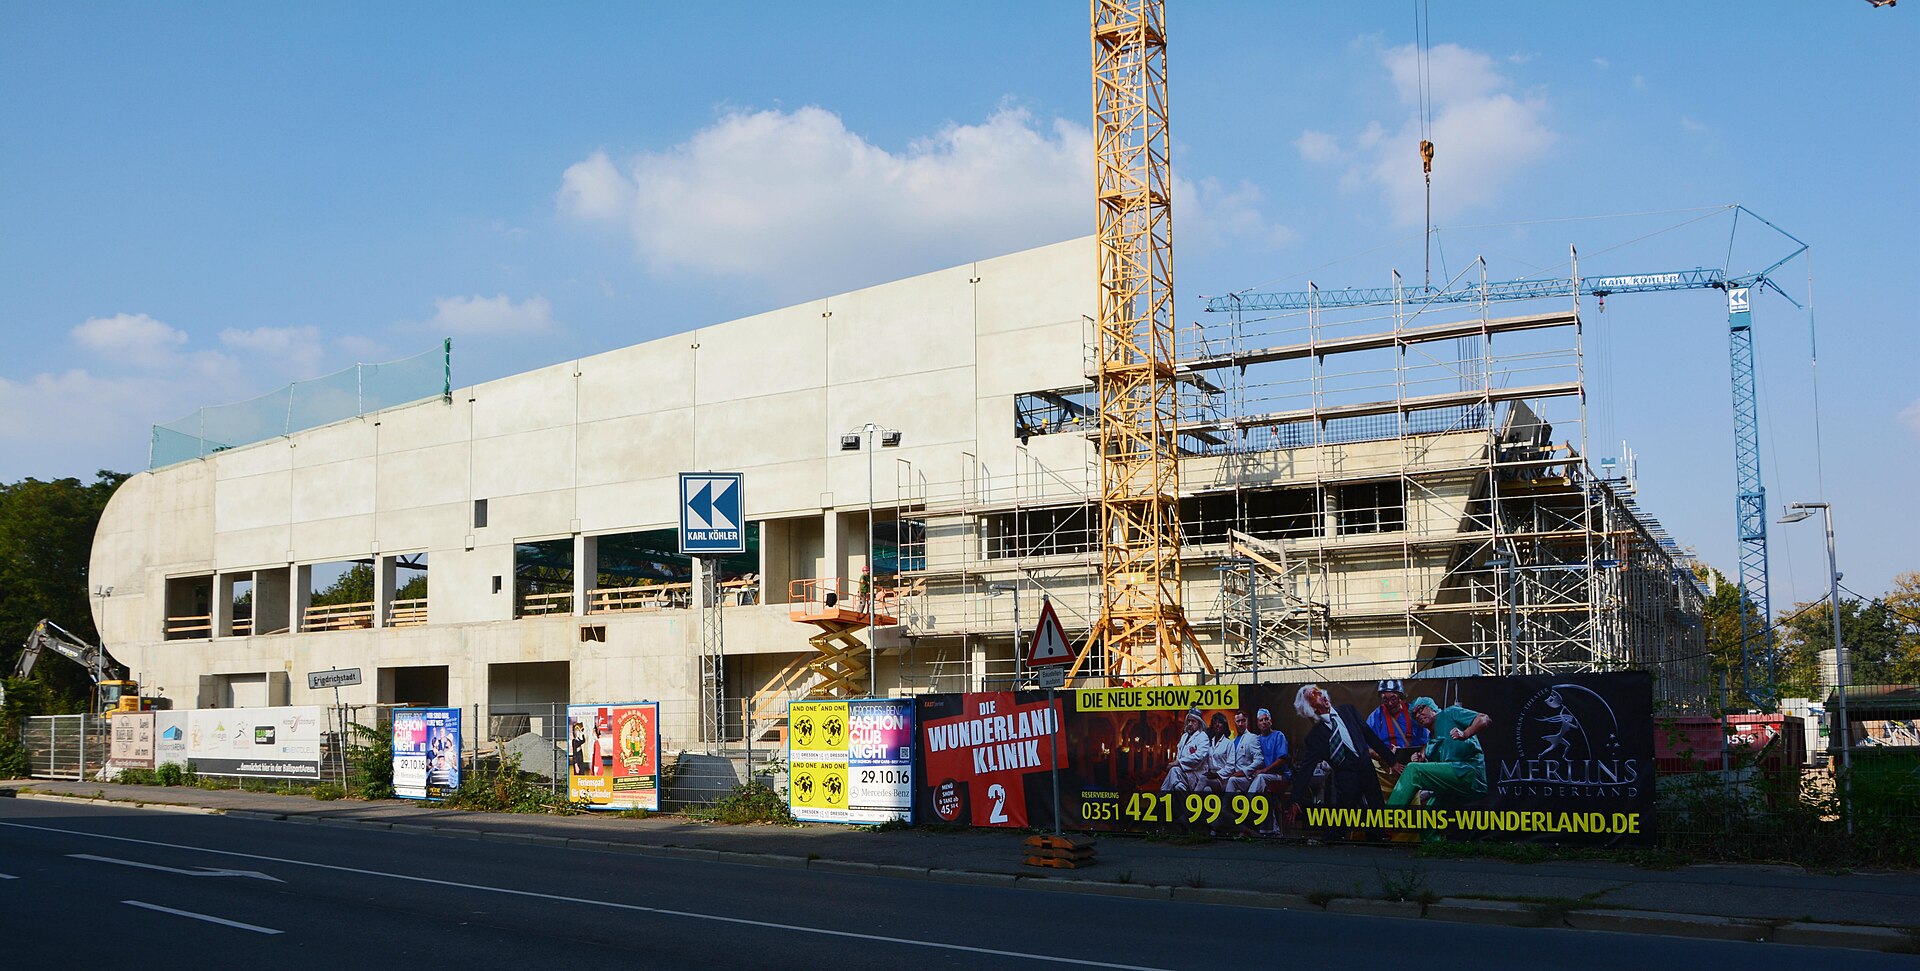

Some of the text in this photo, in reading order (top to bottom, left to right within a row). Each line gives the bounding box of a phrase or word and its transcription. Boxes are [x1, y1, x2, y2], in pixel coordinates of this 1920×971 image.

[688, 529, 738, 540] KARL KÖHLER
[313, 673, 356, 684] Friedrichstadt
[1082, 689, 1233, 708] DIE NEUE SHOW 2016
[979, 701, 996, 716] DIE
[394, 720, 423, 731] FASHION
[849, 715, 903, 730] FASHION
[394, 731, 412, 740] CLUB
[849, 730, 882, 743] CLUB
[928, 708, 1059, 752] WUNDERLAND
[394, 741, 416, 751] NIGHT
[849, 744, 888, 759] NIGHT
[973, 740, 1041, 774] KLINIK
[400, 759, 426, 770] 29.10.16
[861, 770, 910, 784] 29.10.16
[1499, 759, 1638, 784] MERLINS
[577, 777, 605, 788] Ferienspaß
[861, 788, 910, 797] Mercedes-Benz
[1081, 791, 1120, 799] RESERVIERUNG
[1498, 786, 1638, 798] WUNDERLAND
[987, 783, 1009, 824] 2
[1081, 792, 1269, 826] 0351 421 99 99
[1306, 807, 1640, 834] WWW.MERLINS-WUNDERLAND.DE
